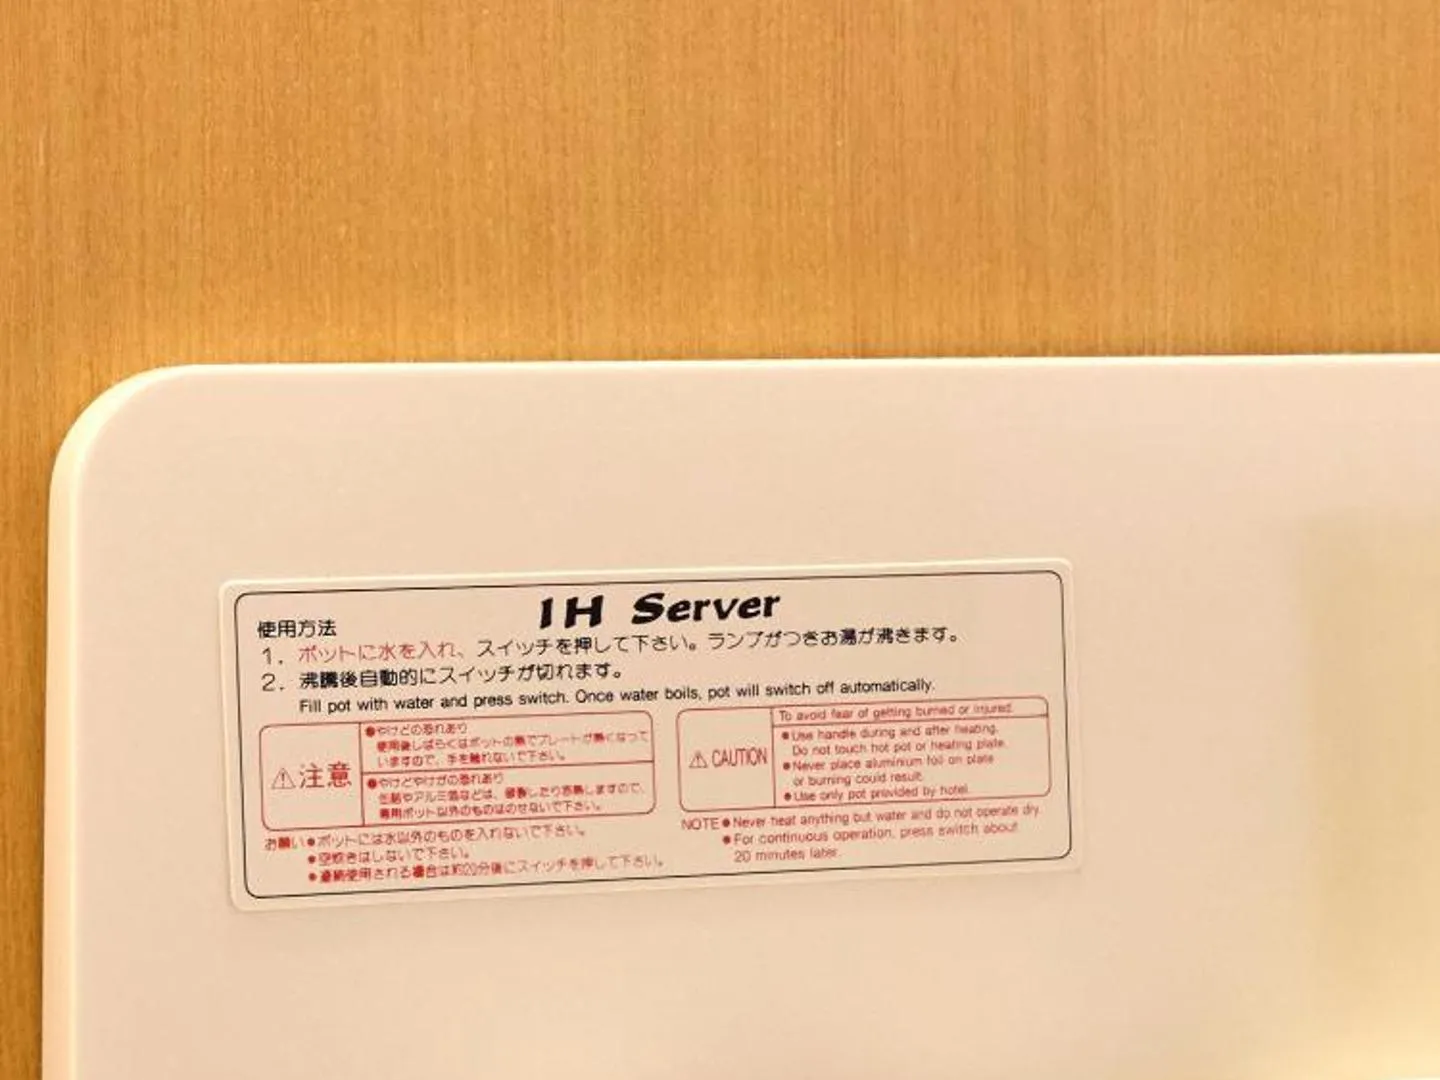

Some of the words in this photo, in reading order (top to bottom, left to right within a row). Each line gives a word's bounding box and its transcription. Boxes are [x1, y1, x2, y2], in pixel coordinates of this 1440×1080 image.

[631, 592, 781, 625] Server
[257, 619, 337, 639] 使用方法
[262, 647, 284, 665] 1.
[262, 673, 285, 692] 2.
[300, 698, 323, 713] Fill
[328, 699, 351, 714] pot
[357, 696, 388, 711] with
[393, 697, 434, 710] water
[440, 694, 467, 709] and
[474, 695, 513, 710] press
[519, 691, 569, 706] switch.
[575, 688, 613, 703] Once
[620, 687, 658, 702] water
[708, 685, 731, 701] pot
[736, 682, 760, 698] will
[765, 682, 811, 697] switch
[817, 679, 834, 695] off
[840, 678, 936, 696] automatically.
[779, 710, 792, 721] To
[797, 709, 826, 721] avoid
[831, 708, 853, 720] fear
[858, 707, 870, 718] of
[873, 706, 912, 720] getting
[915, 704, 955, 717] burned
[958, 705, 969, 714] or
[792, 730, 813, 741] Use
[817, 728, 856, 740] handle
[860, 727, 895, 739] during
[899, 725, 921, 737] and
[925, 724, 950, 736] after
[792, 744, 808, 755] Do
[812, 743, 830, 755] not
[834, 742, 866, 754] touch
[871, 740, 890, 753] hot
[894, 741, 912, 754] pot
[915, 741, 926, 751] or
[930, 738, 972, 751] heating
[711, 747, 768, 767] CAUTION
[793, 759, 825, 771] Never
[830, 758, 861, 771] place
[927, 753, 944, 765] foil
[948, 754, 963, 764] on
[299, 761, 352, 789] 注意
[793, 776, 804, 786] or
[808, 774, 851, 786] burning
[855, 771, 886, 783] could
[794, 790, 816, 801] Use
[820, 788, 843, 800] only
[848, 788, 866, 800] pot
[871, 783, 918, 799] provided
[923, 783, 935, 797] by
[681, 817, 720, 831] NOTE
[733, 816, 765, 829] Never
[770, 814, 797, 827] heat
[800, 812, 849, 828] anything
[854, 810, 871, 823] but
[876, 809, 907, 822] water
[911, 808, 932, 820] and
[936, 806, 950, 819] do
[954, 805, 973, 818] not
[976, 804, 1019, 819] operate
[734, 832, 754, 845] For
[758, 829, 829, 843] continuous
[900, 825, 934, 839] press
[938, 822, 979, 836] switch
[983, 821, 1018, 834] about
[734, 850, 751, 863] 20
[755, 848, 805, 861] minutes
